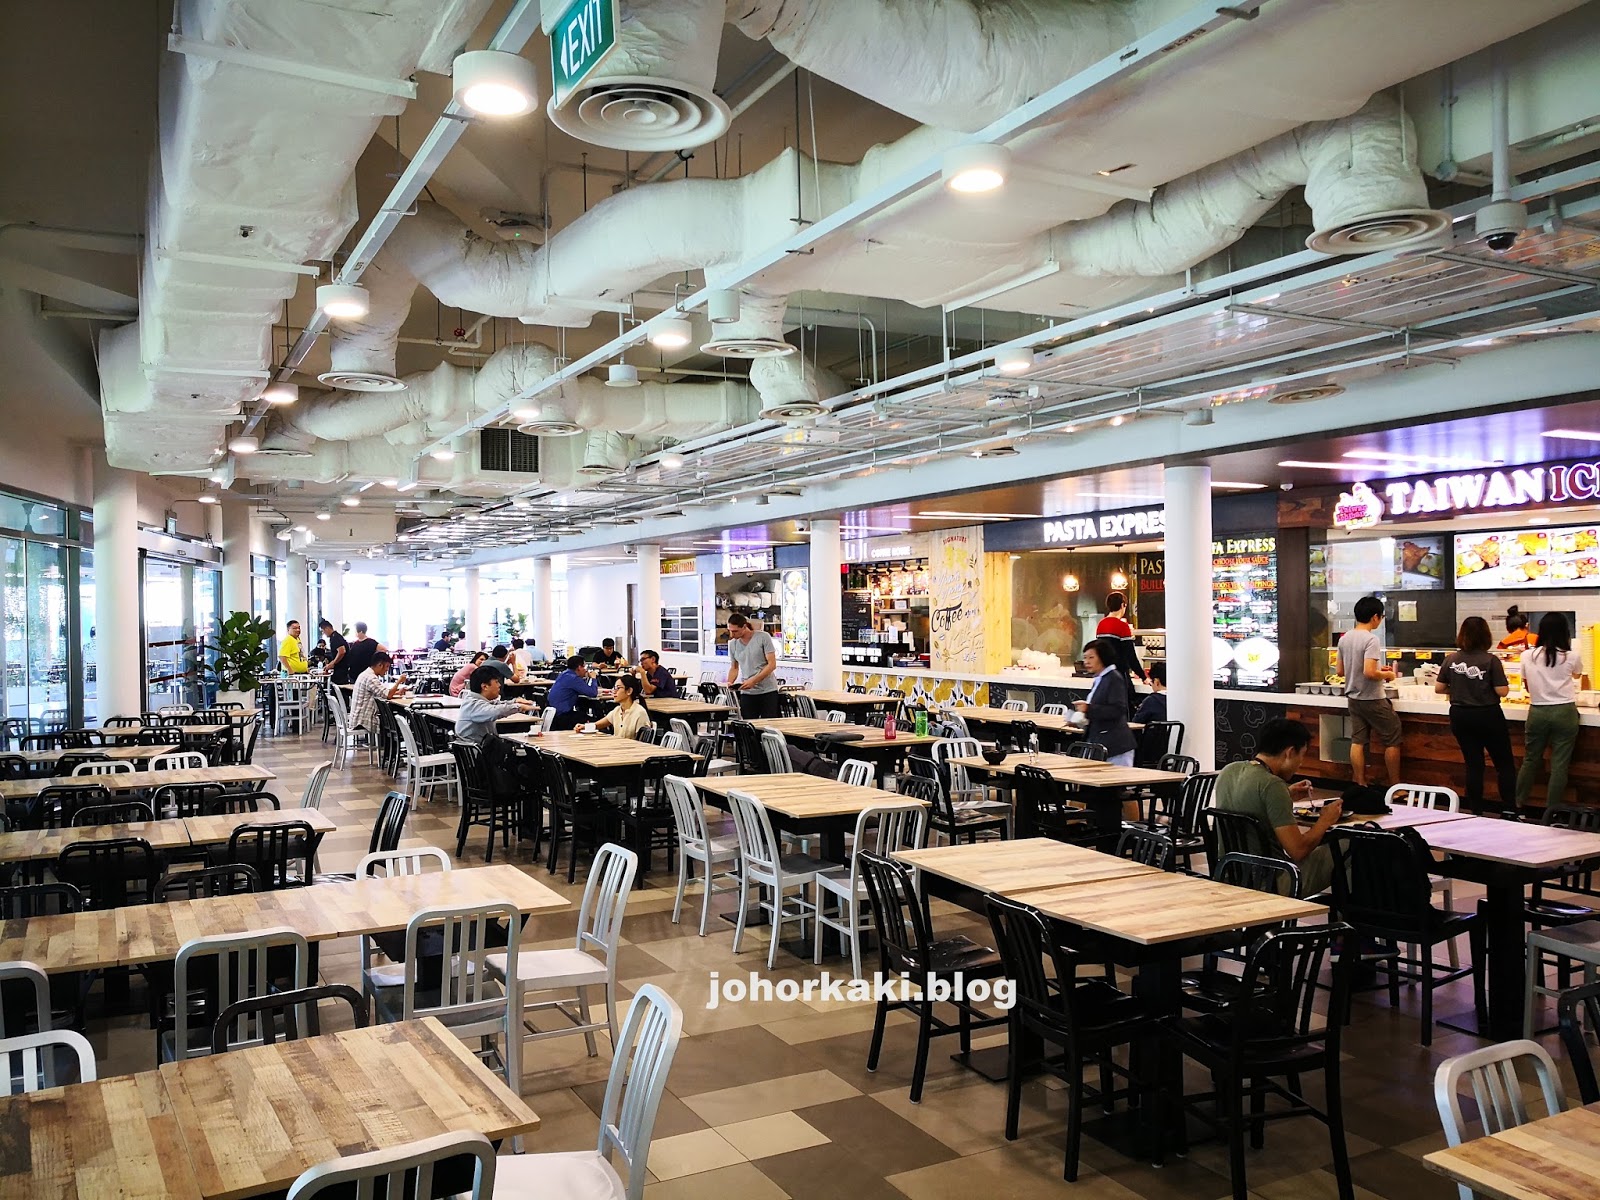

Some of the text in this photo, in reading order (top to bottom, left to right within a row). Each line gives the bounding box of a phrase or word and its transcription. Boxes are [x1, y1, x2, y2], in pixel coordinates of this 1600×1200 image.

[568, 0, 603, 76] EXIT
[1386, 462, 1600, 515] TAIWAN IC
[1043, 518, 1097, 542] PASTA
[1140, 558, 1164, 575] PAS
[931, 600, 963, 633] Coffee
